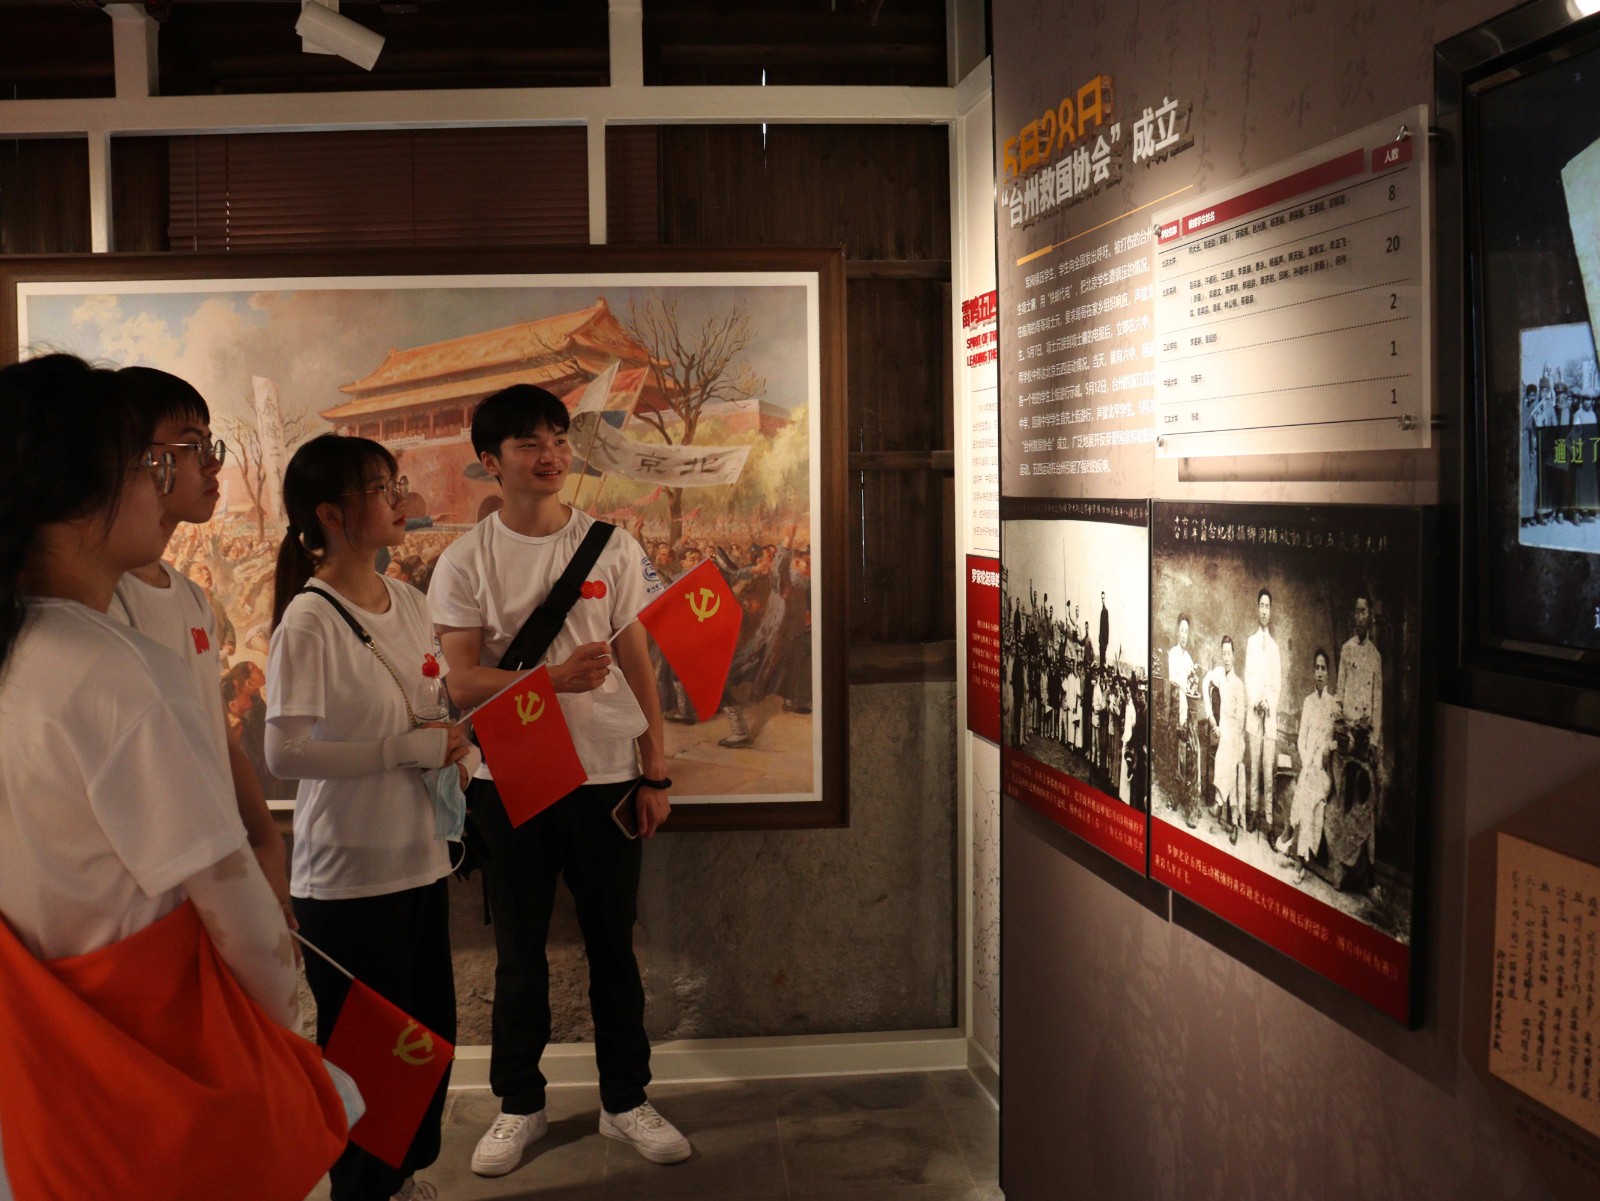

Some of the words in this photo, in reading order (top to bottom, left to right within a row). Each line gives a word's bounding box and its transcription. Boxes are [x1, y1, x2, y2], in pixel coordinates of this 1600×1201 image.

[1388, 185, 1396, 201] 8
[1386, 236, 1400, 254] 20
[1390, 293, 1397, 310] 2
[1391, 340, 1398, 356] 1
[1391, 389, 1398, 405] 1
[1553, 437, 1600, 465] 通过了
